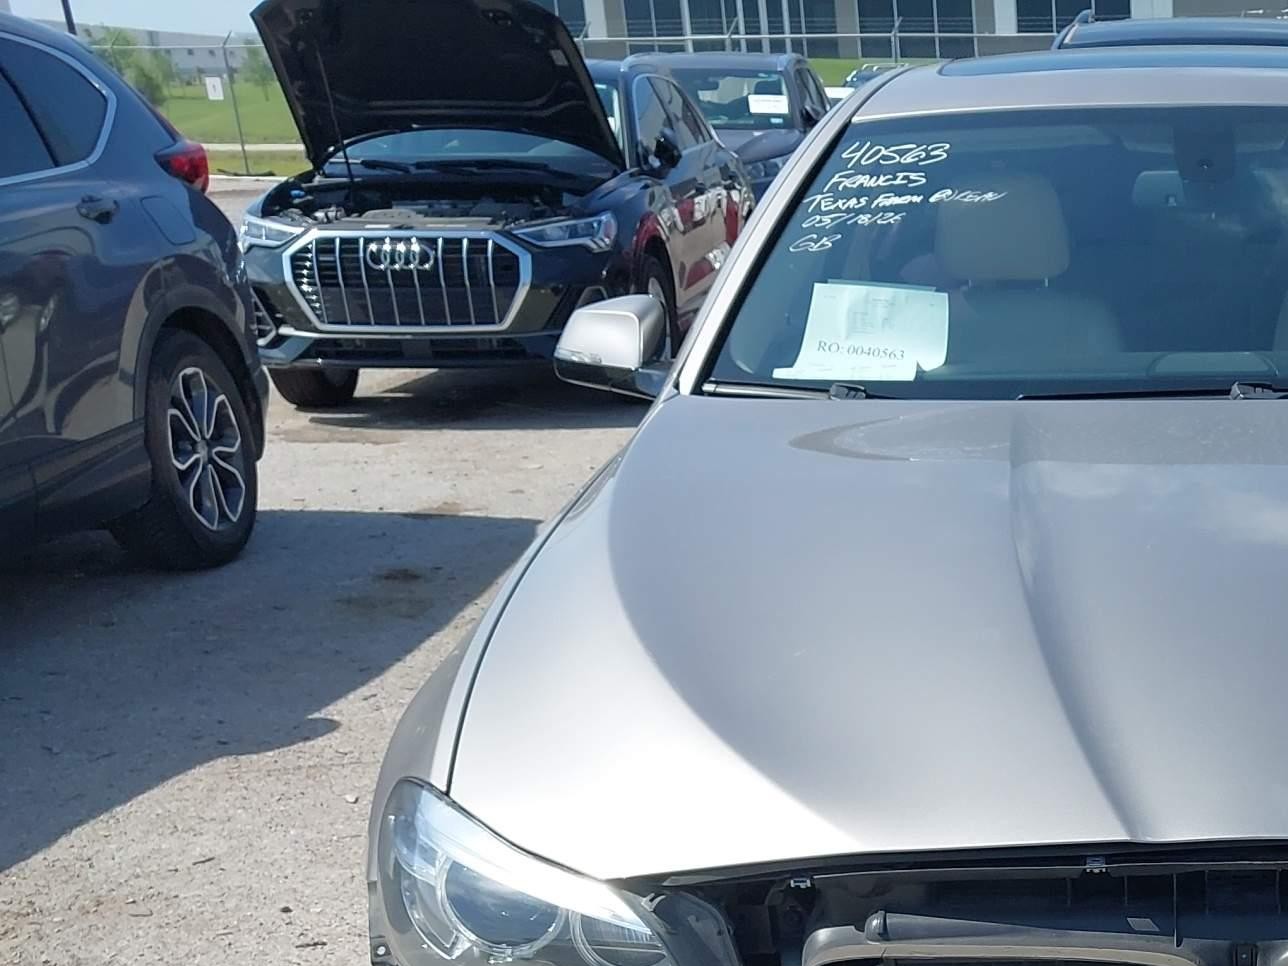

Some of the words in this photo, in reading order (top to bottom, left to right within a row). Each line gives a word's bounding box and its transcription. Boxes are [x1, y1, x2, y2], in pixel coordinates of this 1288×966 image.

[841, 141, 951, 169] 40563
[823, 170, 928, 193] FRANCIS
[803, 192, 869, 213] TEXAS
[817, 339, 845, 353] RO:
[847, 343, 905, 361] 0040563
